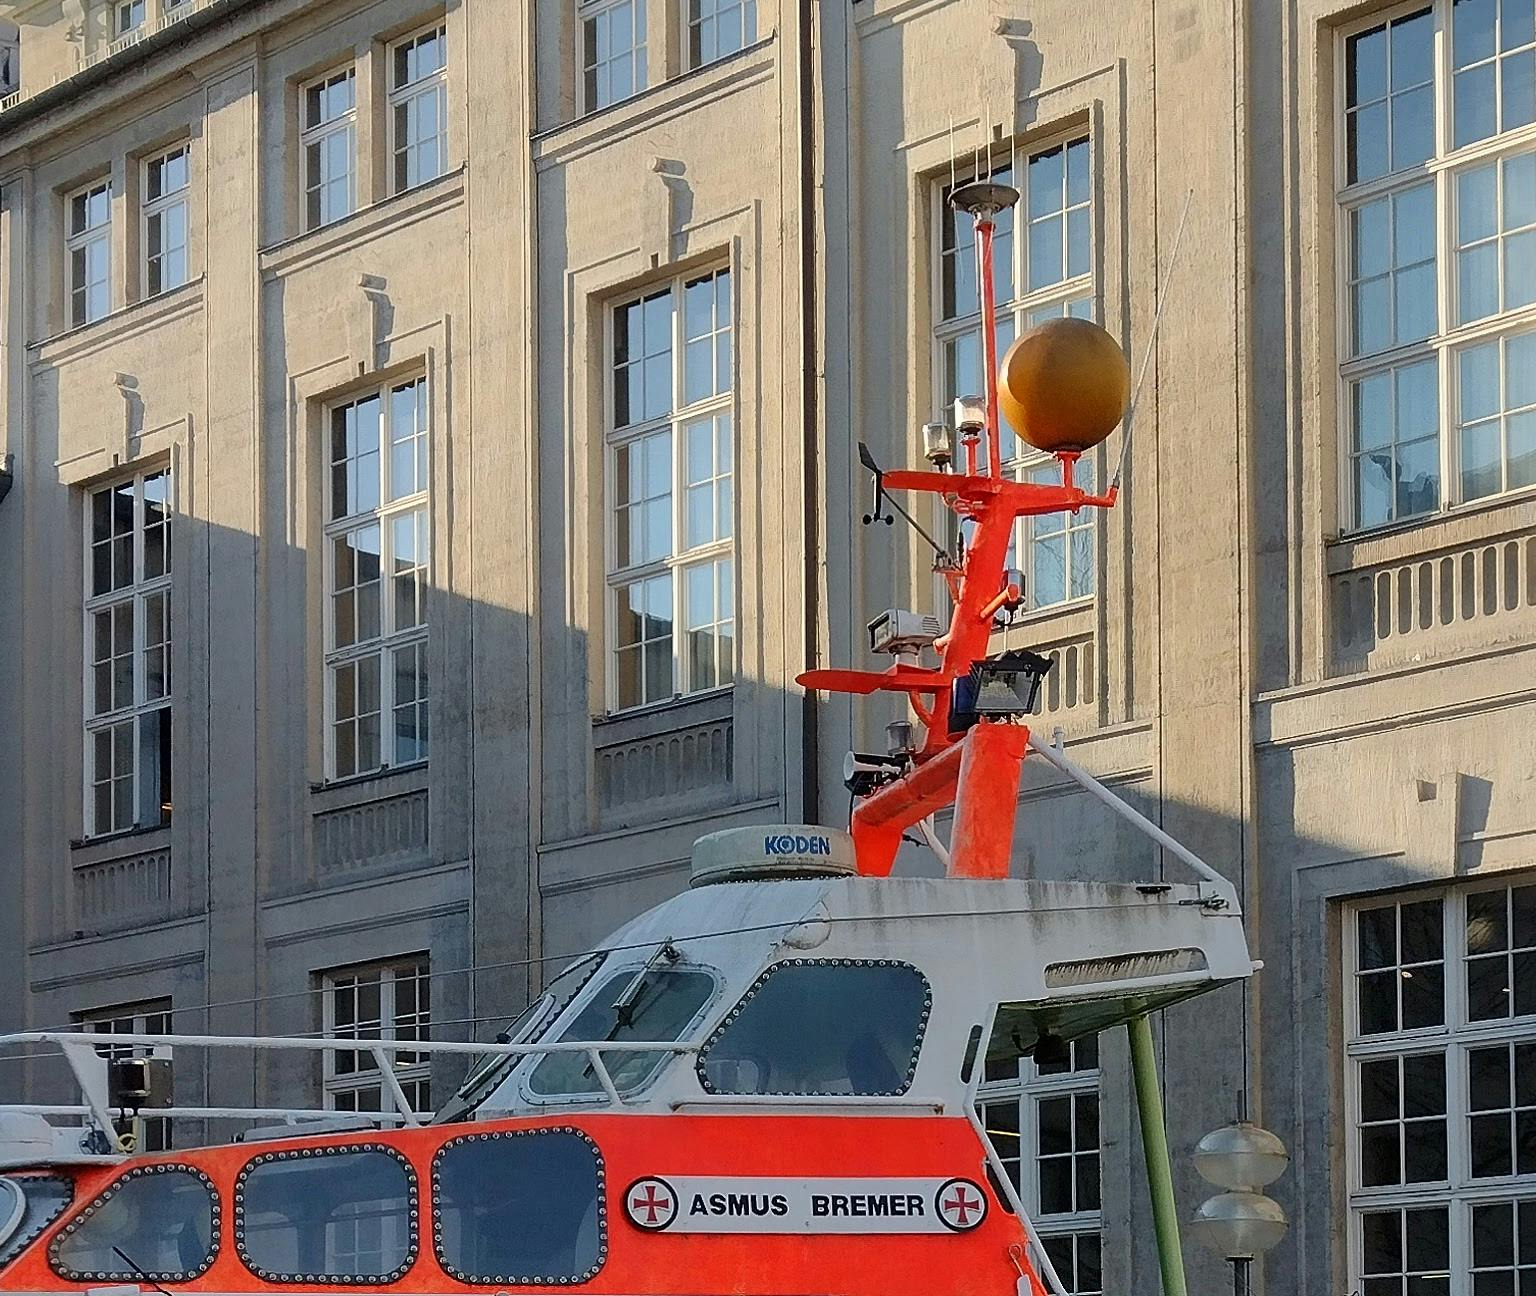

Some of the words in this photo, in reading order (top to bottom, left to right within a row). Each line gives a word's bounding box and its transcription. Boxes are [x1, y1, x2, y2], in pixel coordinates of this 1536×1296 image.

[764, 835, 831, 856] KODEN
[689, 1193, 789, 1217] ASMUS
[811, 1194, 925, 1217] BREMER
